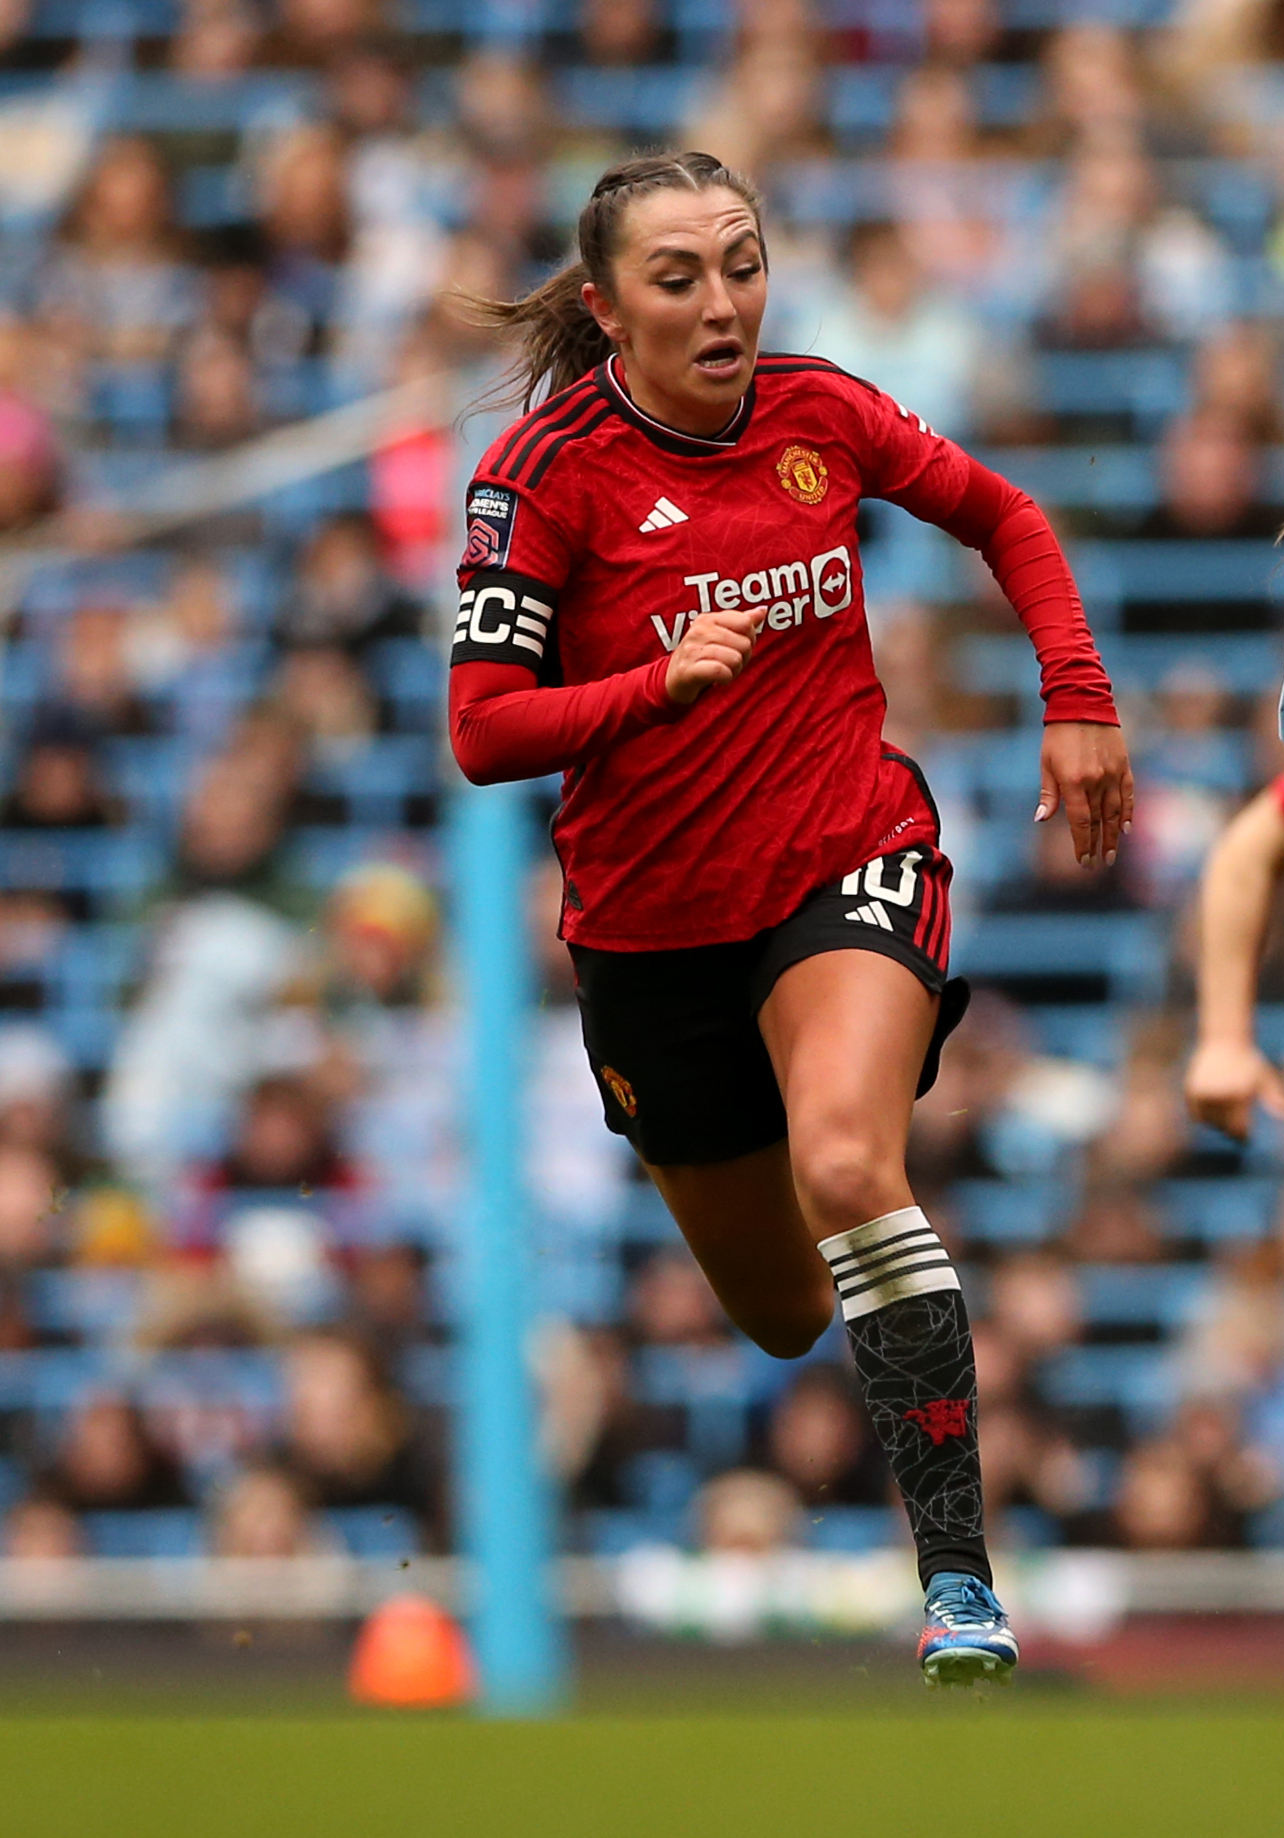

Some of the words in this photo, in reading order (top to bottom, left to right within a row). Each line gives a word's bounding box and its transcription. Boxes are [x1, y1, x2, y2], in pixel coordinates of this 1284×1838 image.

[799, 486, 824, 501] UNITED
[683, 561, 810, 613] Team
[650, 593, 811, 652] Vier
[841, 850, 924, 907] 10
